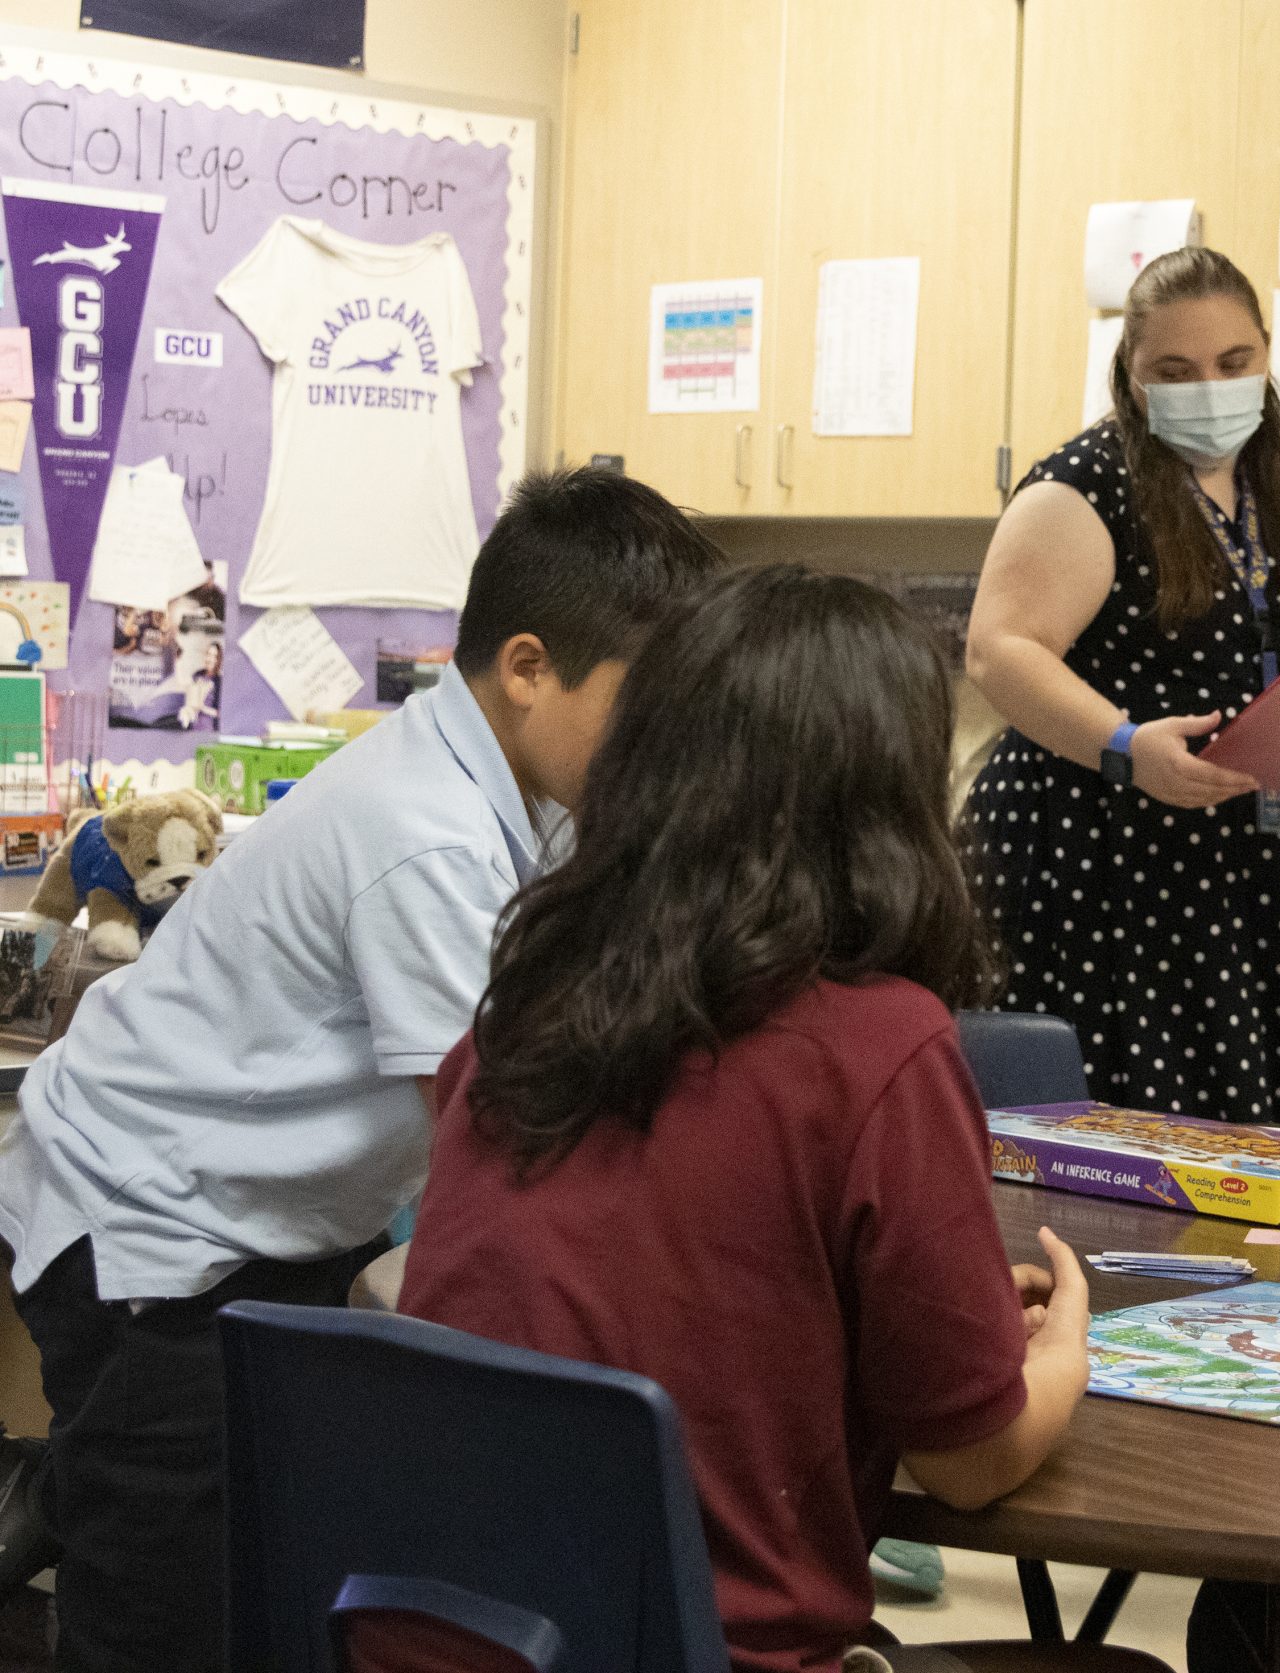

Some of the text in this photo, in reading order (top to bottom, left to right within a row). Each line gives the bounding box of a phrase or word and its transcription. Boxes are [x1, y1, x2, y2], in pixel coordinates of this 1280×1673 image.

[19, 101, 457, 234] College Corner
[165, 335, 212, 358] GCU
[309, 296, 439, 376] GRAND CANYON
[57, 274, 104, 440] GCU
[140, 373, 210, 436] Lopes
[308, 384, 438, 414] UNIVERSITY
[1051, 1161, 1141, 1189] AN INFERENCE GAME
[1186, 1174, 1216, 1189] Reading
[1222, 1180, 1246, 1191] Level 2
[1195, 1188, 1251, 1207] Comprehension
